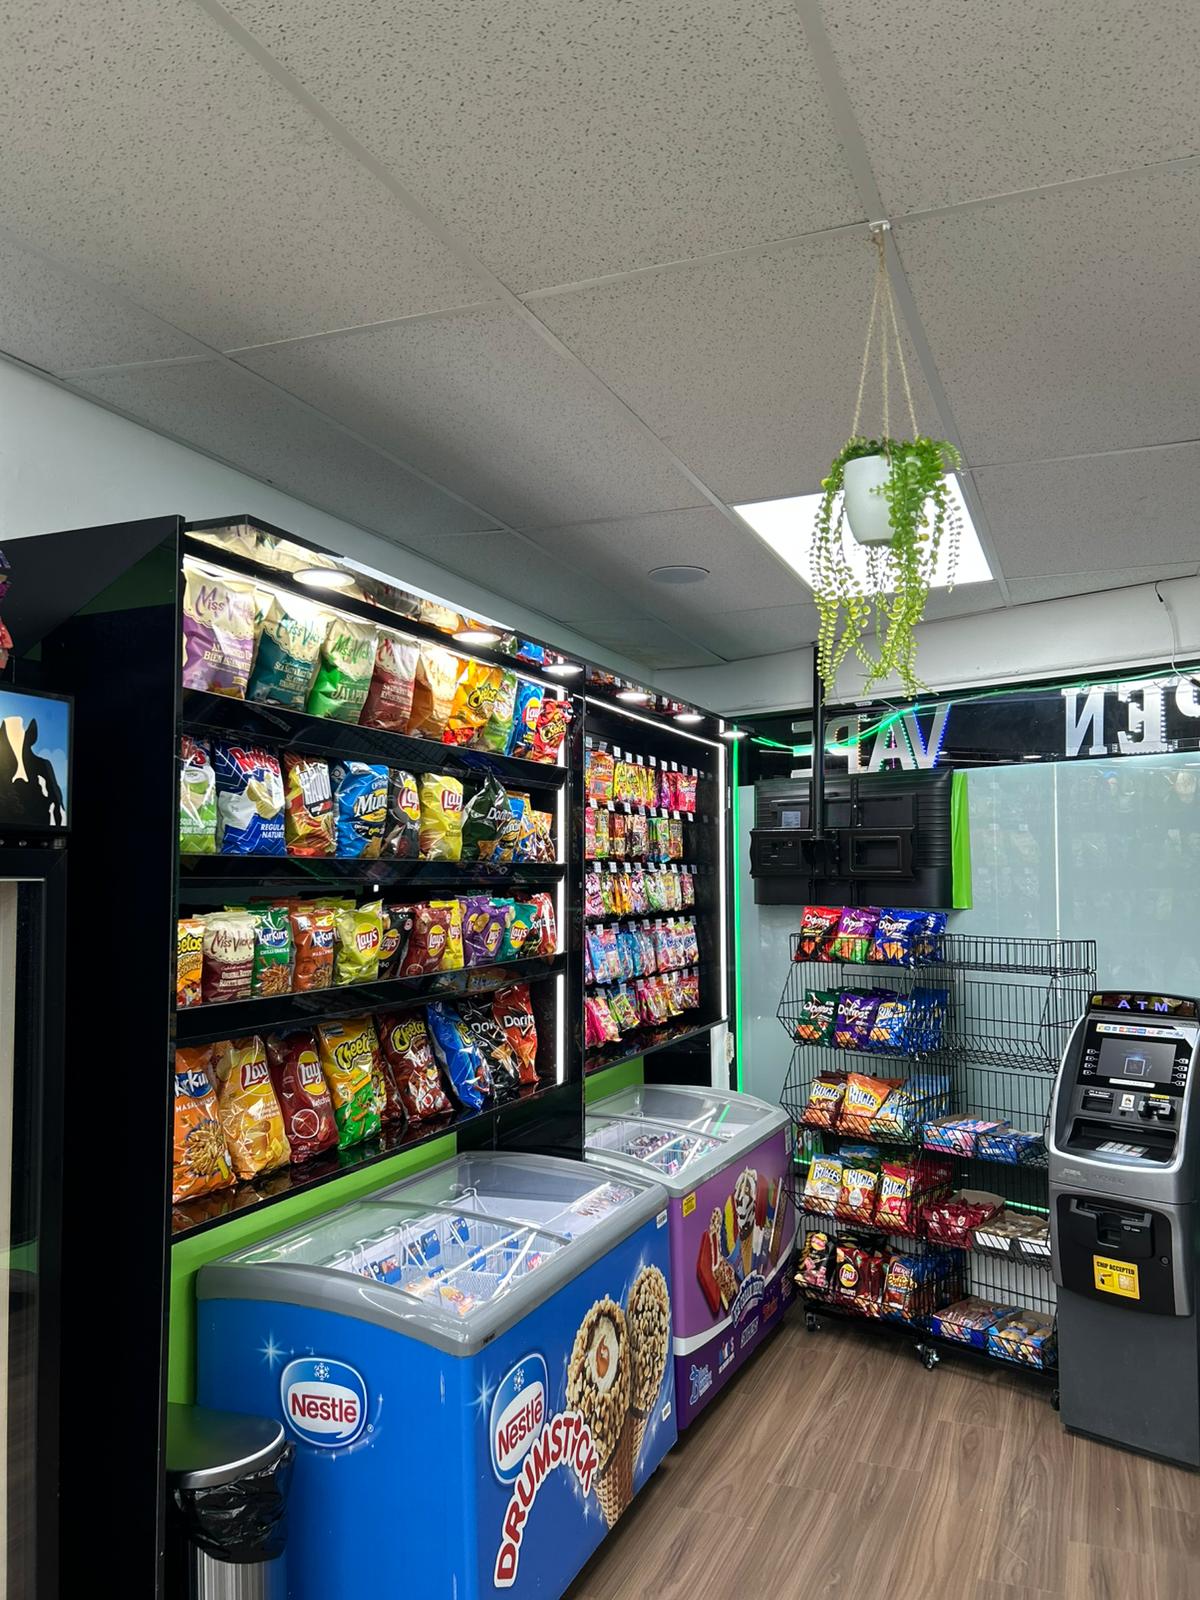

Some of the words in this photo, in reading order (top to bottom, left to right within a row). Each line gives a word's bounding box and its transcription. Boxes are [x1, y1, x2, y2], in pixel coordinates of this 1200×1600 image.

[260, 823, 285, 831] REGULA
[878, 919, 909, 931] Doritos
[210, 930, 232, 955] Miss
[355, 927, 379, 951] Lay's
[243, 1062, 271, 1088] Lay
[1096, 1261, 1109, 1269] CHIP
[1109, 1263, 1135, 1276] ACCEPTED
[291, 1392, 357, 1424] Nestlé
[497, 1390, 544, 1462] Nestlé
